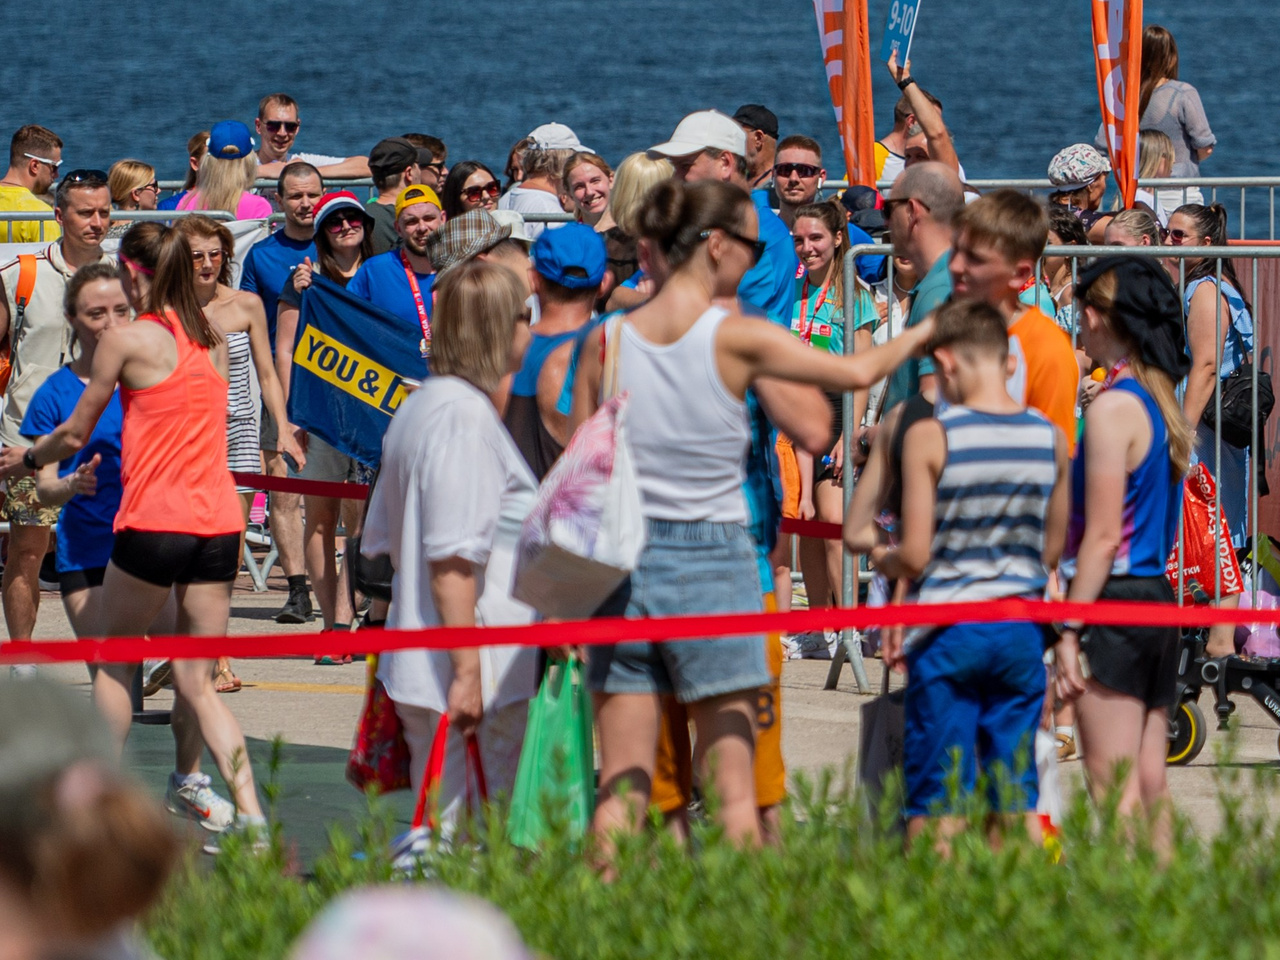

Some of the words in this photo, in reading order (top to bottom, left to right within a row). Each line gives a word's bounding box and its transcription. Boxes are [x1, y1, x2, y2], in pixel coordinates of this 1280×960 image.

[888, 0, 914, 36] 9-10
[307, 335, 360, 383] YOU
[358, 369, 380, 398] &
